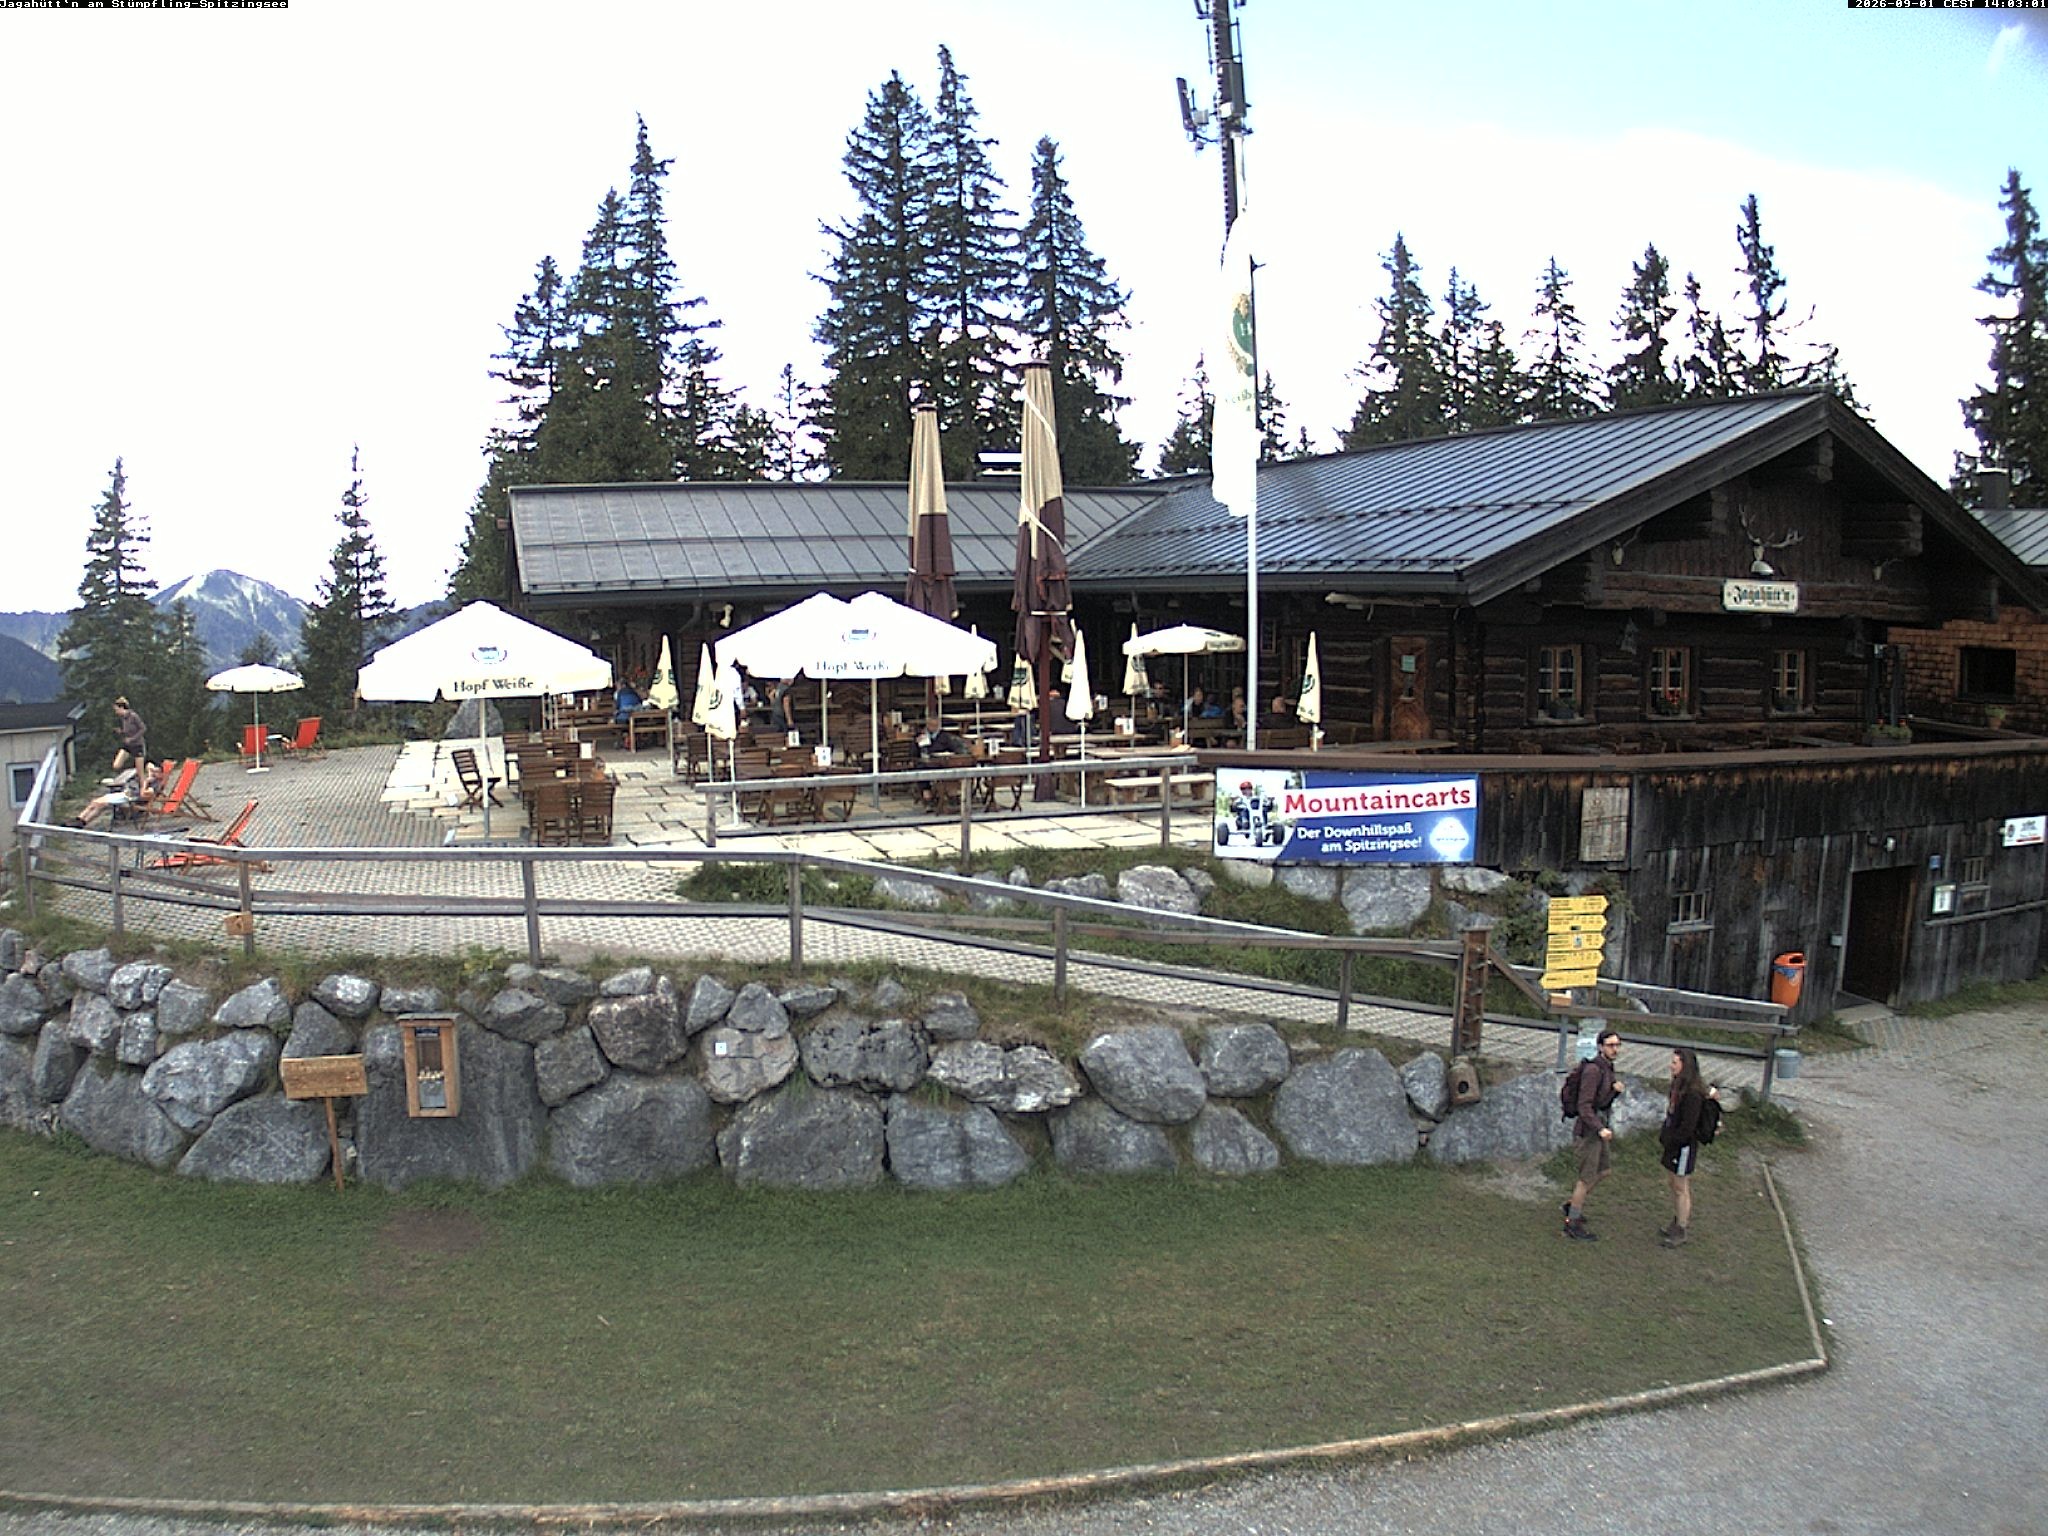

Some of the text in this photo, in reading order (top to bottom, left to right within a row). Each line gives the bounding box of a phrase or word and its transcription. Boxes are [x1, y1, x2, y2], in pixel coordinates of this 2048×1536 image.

[453, 678, 489, 694] Hopf
[1284, 786, 1471, 814] Mountaincarts
[1297, 822, 1413, 840] Der Downhillspaß
[1321, 843, 1342, 853] am
[1344, 837, 1422, 854] Spitzingsee!
